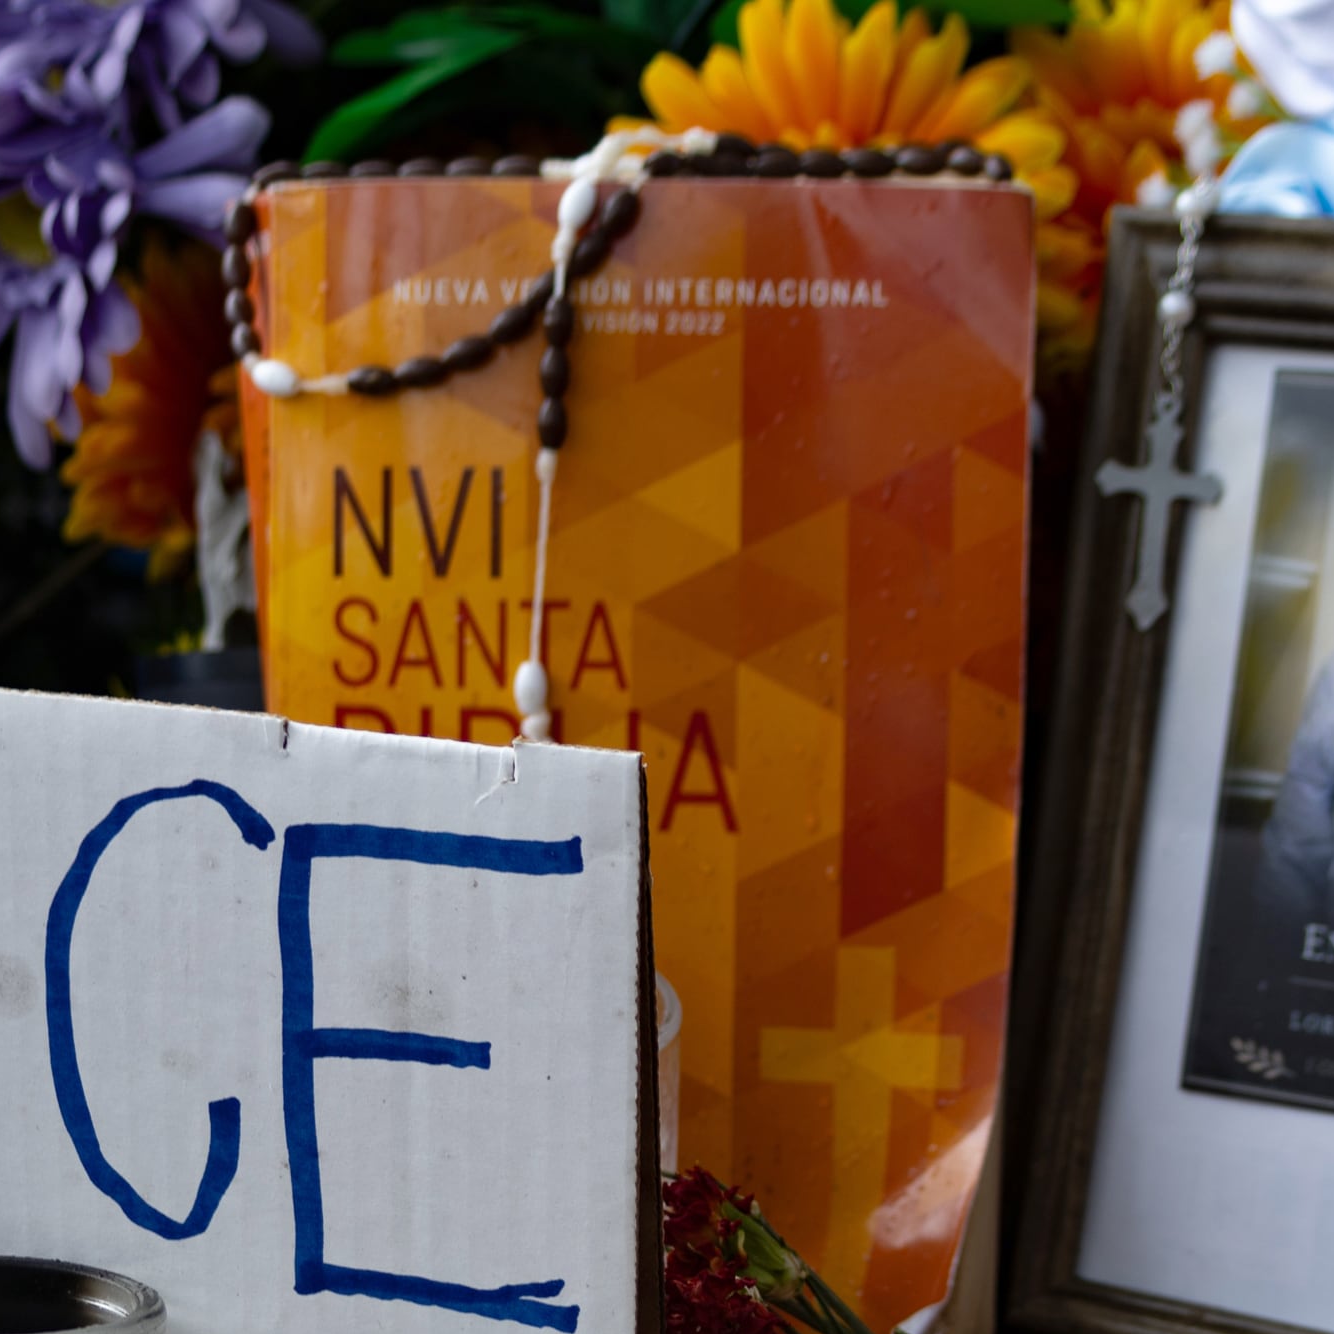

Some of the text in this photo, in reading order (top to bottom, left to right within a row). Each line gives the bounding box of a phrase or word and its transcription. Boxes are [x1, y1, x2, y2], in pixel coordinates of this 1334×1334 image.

[393, 277, 890, 309] NUEVA VEIÓN INTERNACIONAL
[582, 310, 726, 336] VISIÓN 2022
[333, 466, 503, 578] NVI
[333, 598, 627, 690] SANTA
